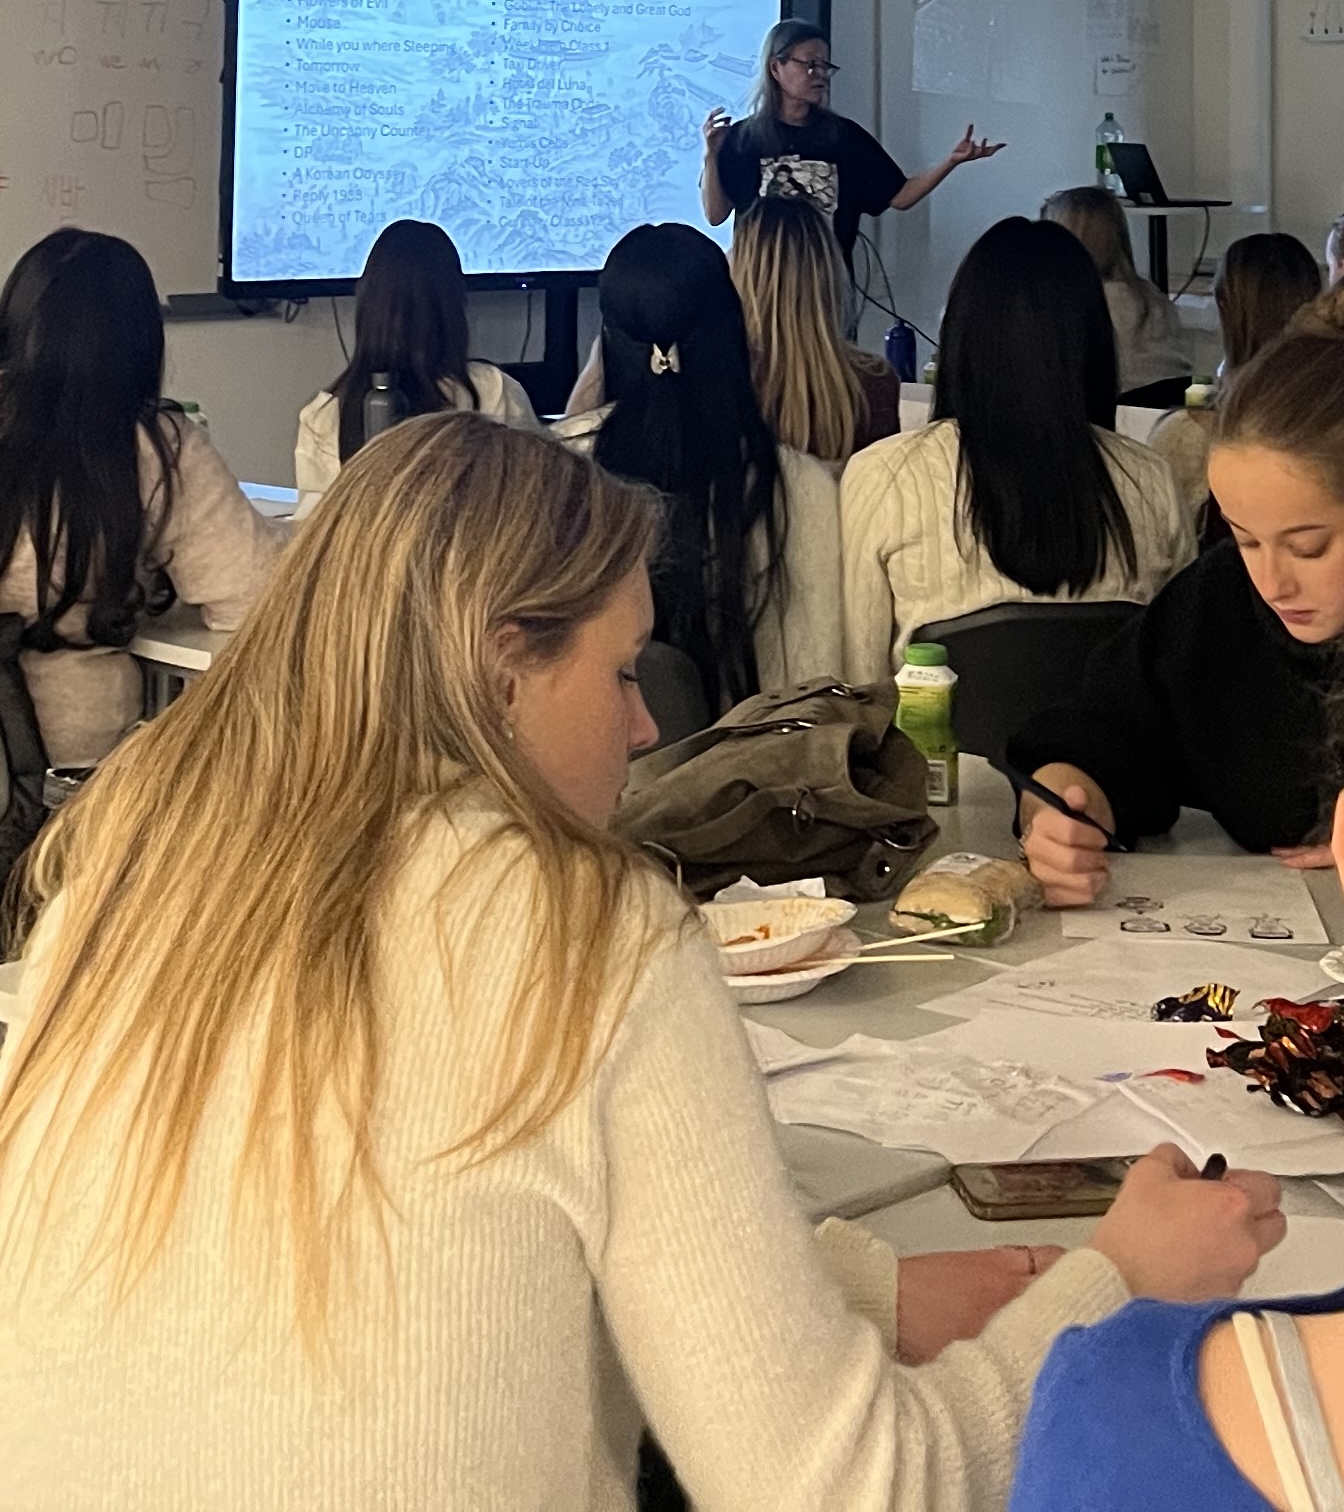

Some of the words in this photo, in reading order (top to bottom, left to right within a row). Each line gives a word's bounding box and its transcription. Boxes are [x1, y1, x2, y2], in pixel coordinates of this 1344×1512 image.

[612, 3, 633, 15] and
[636, 3, 666, 15] Great
[668, 4, 691, 17] God
[297, 16, 341, 29] Mouse
[503, 18, 542, 33] Family
[545, 20, 558, 34] by
[561, 20, 601, 33] Choice
[296, 38, 333, 51] While
[336, 40, 359, 54] you
[362, 40, 400, 52] where
[403, 40, 456, 57] Sleeping
[296, 58, 361, 72] Tomorrow
[295, 81, 330, 94] Move
[333, 82, 345, 94] to
[349, 80, 397, 94] Heaven
[557, 78, 586, 90] Luna
[353, 103, 366, 115] of
[369, 102, 404, 116] Souls
[294, 124, 317, 137] The
[321, 125, 377, 139] Uncanny
[294, 146, 312, 158] DP
[293, 168, 302, 180] A
[305, 168, 350, 180] Korean
[293, 189, 329, 204] Reply
[354, 210, 387, 223] Tears
